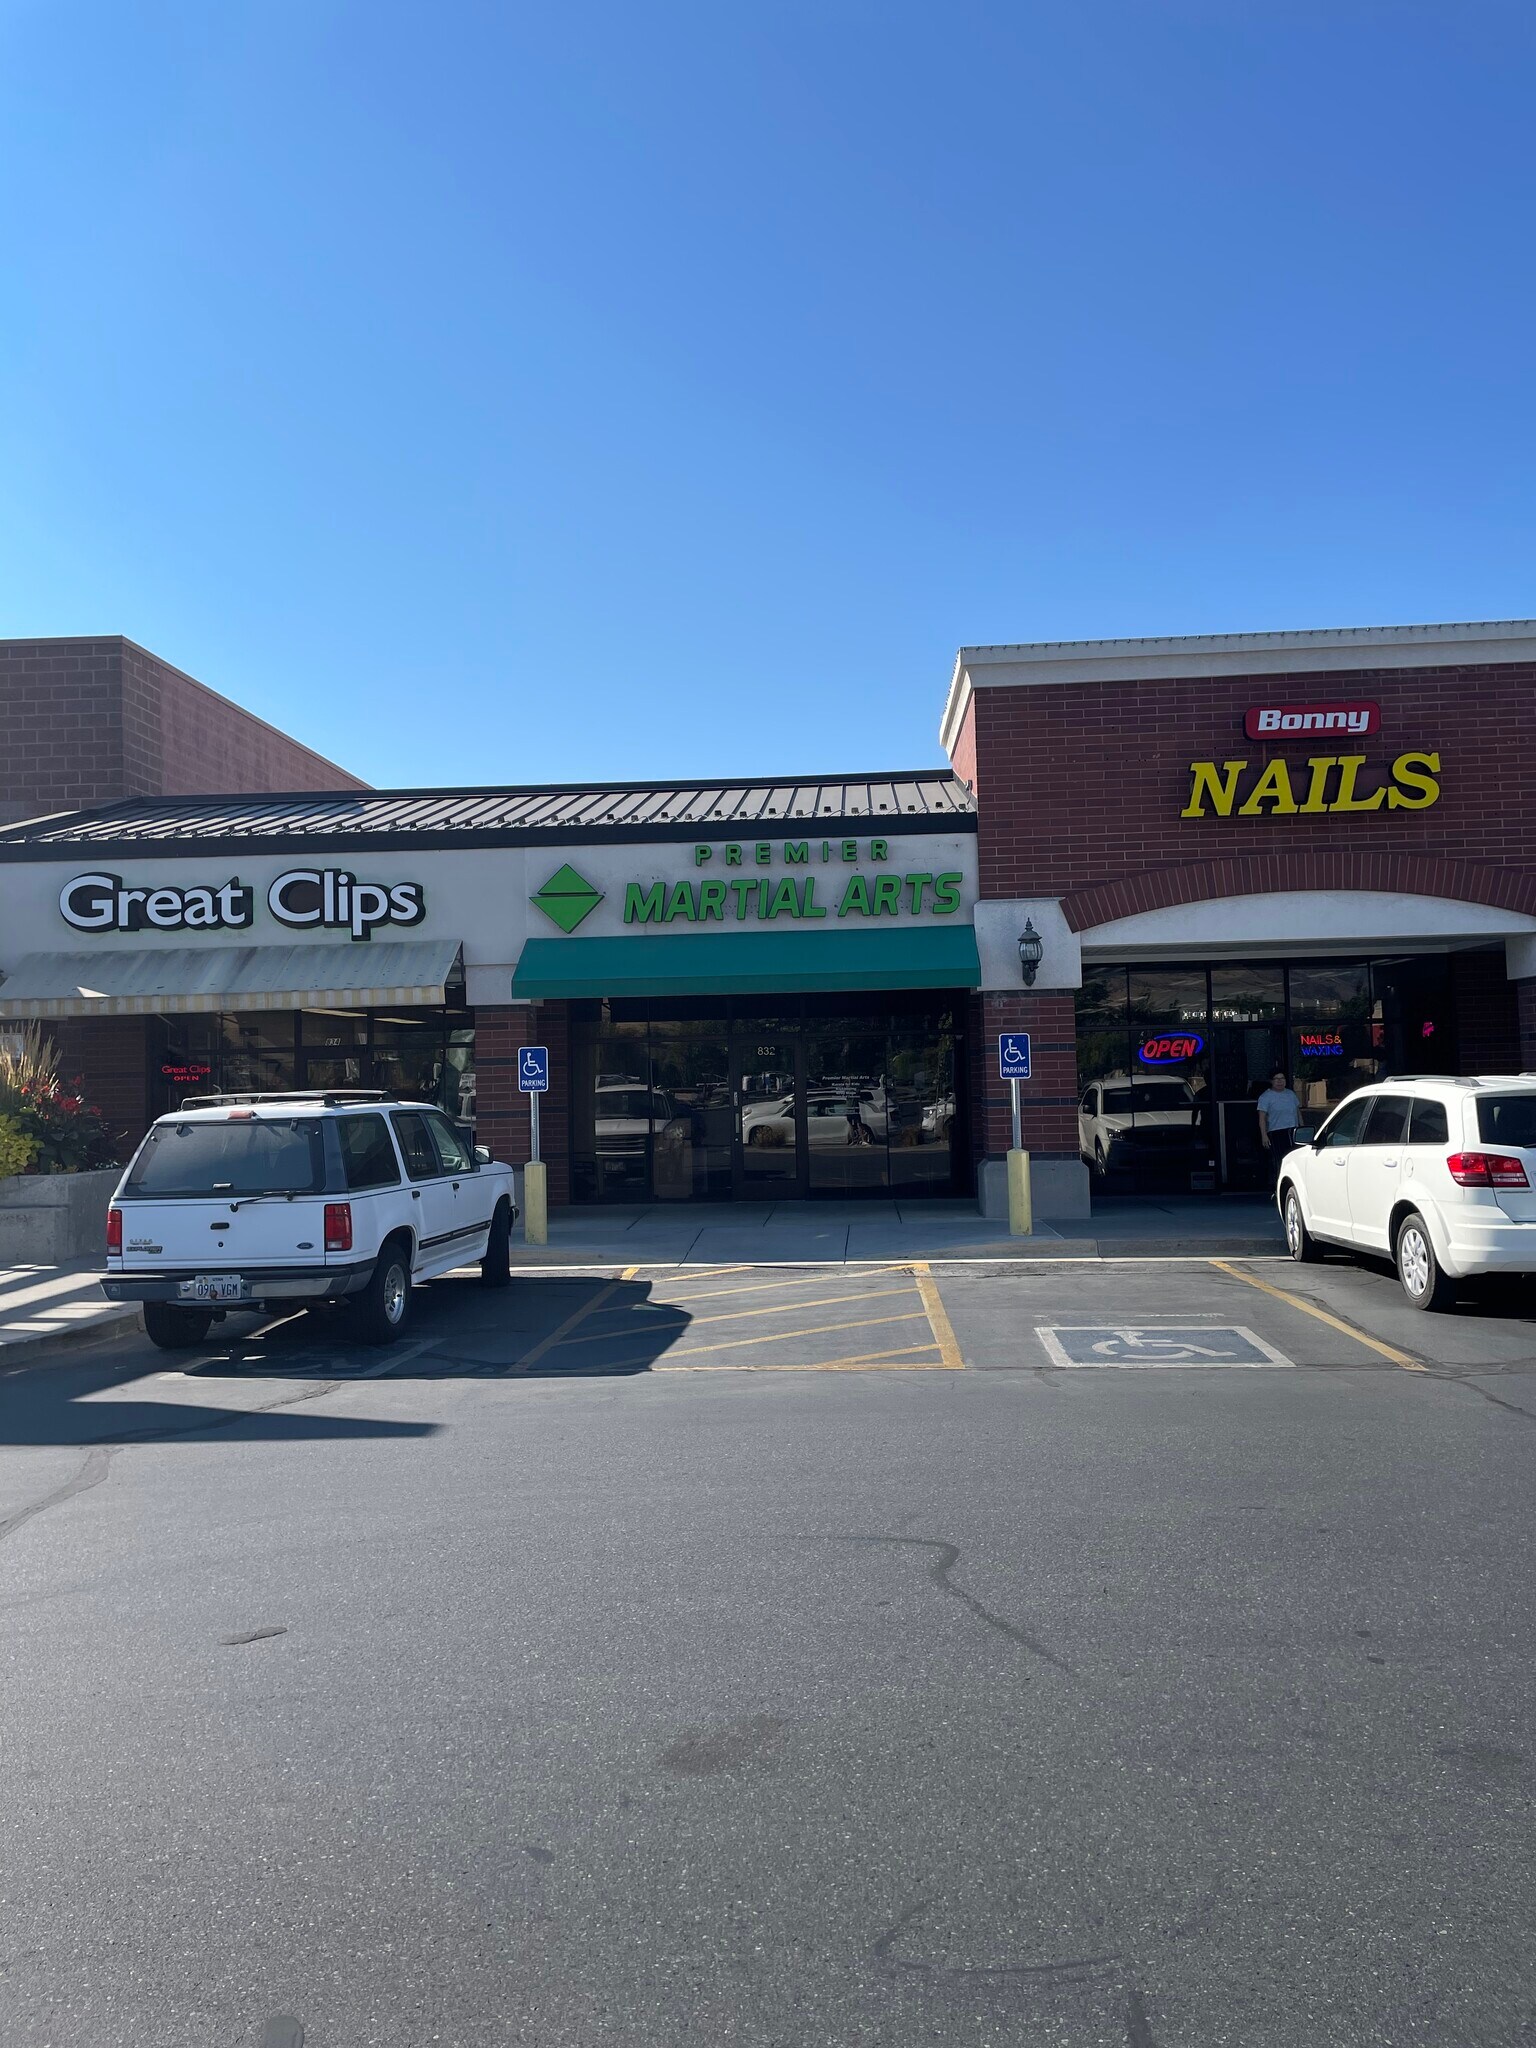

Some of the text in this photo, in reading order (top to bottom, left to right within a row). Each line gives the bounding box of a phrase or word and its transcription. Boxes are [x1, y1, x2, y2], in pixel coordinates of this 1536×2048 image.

[1257, 709, 1370, 733] Bonny
[1180, 752, 1442, 818] NAILS
[694, 839, 888, 867] PREMIER
[59, 870, 421, 938] Great Clips
[623, 871, 964, 924] MARTIAL ARTS
[757, 1046, 776, 1056] 832
[1143, 1039, 1197, 1058] OPEN
[1301, 1045, 1344, 1056] WAXING
[161, 1064, 211, 1075] Great Clips
[1002, 1066, 1028, 1074] PARKING
[521, 1079, 546, 1087] PARKING
[221, 1283, 238, 1296] VGM
